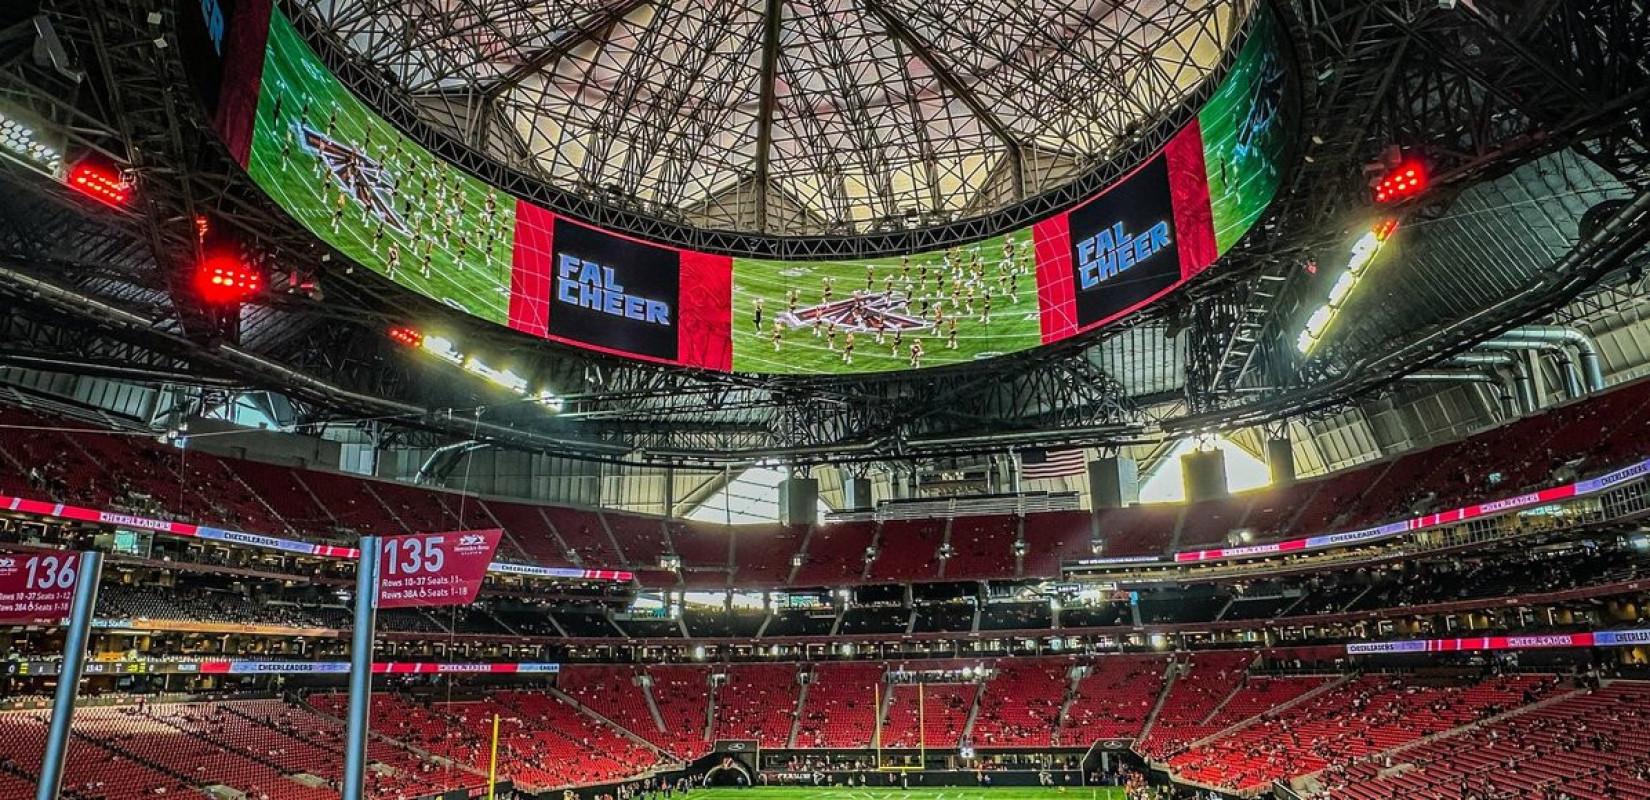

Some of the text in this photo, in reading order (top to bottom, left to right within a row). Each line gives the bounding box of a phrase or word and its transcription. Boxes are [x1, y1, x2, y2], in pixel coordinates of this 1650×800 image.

[1076, 221, 1133, 266] FAL
[1079, 220, 1172, 291] CHEER
[558, 252, 624, 293] FAL
[557, 275, 670, 325] CHEER
[224, 532, 280, 547] CHEERLEADERS
[1330, 529, 1381, 543] CHEERLEADERS
[384, 536, 444, 575] 135
[25, 556, 76, 589] 136
[382, 578, 402, 587] Rows
[427, 575, 448, 586] Seats
[37, 592, 55, 600] Seats
[382, 591, 402, 599] Rows
[427, 587, 448, 597] Seats
[34, 602, 52, 611] Seats
[1508, 635, 1572, 646] CHEERLEADERS
